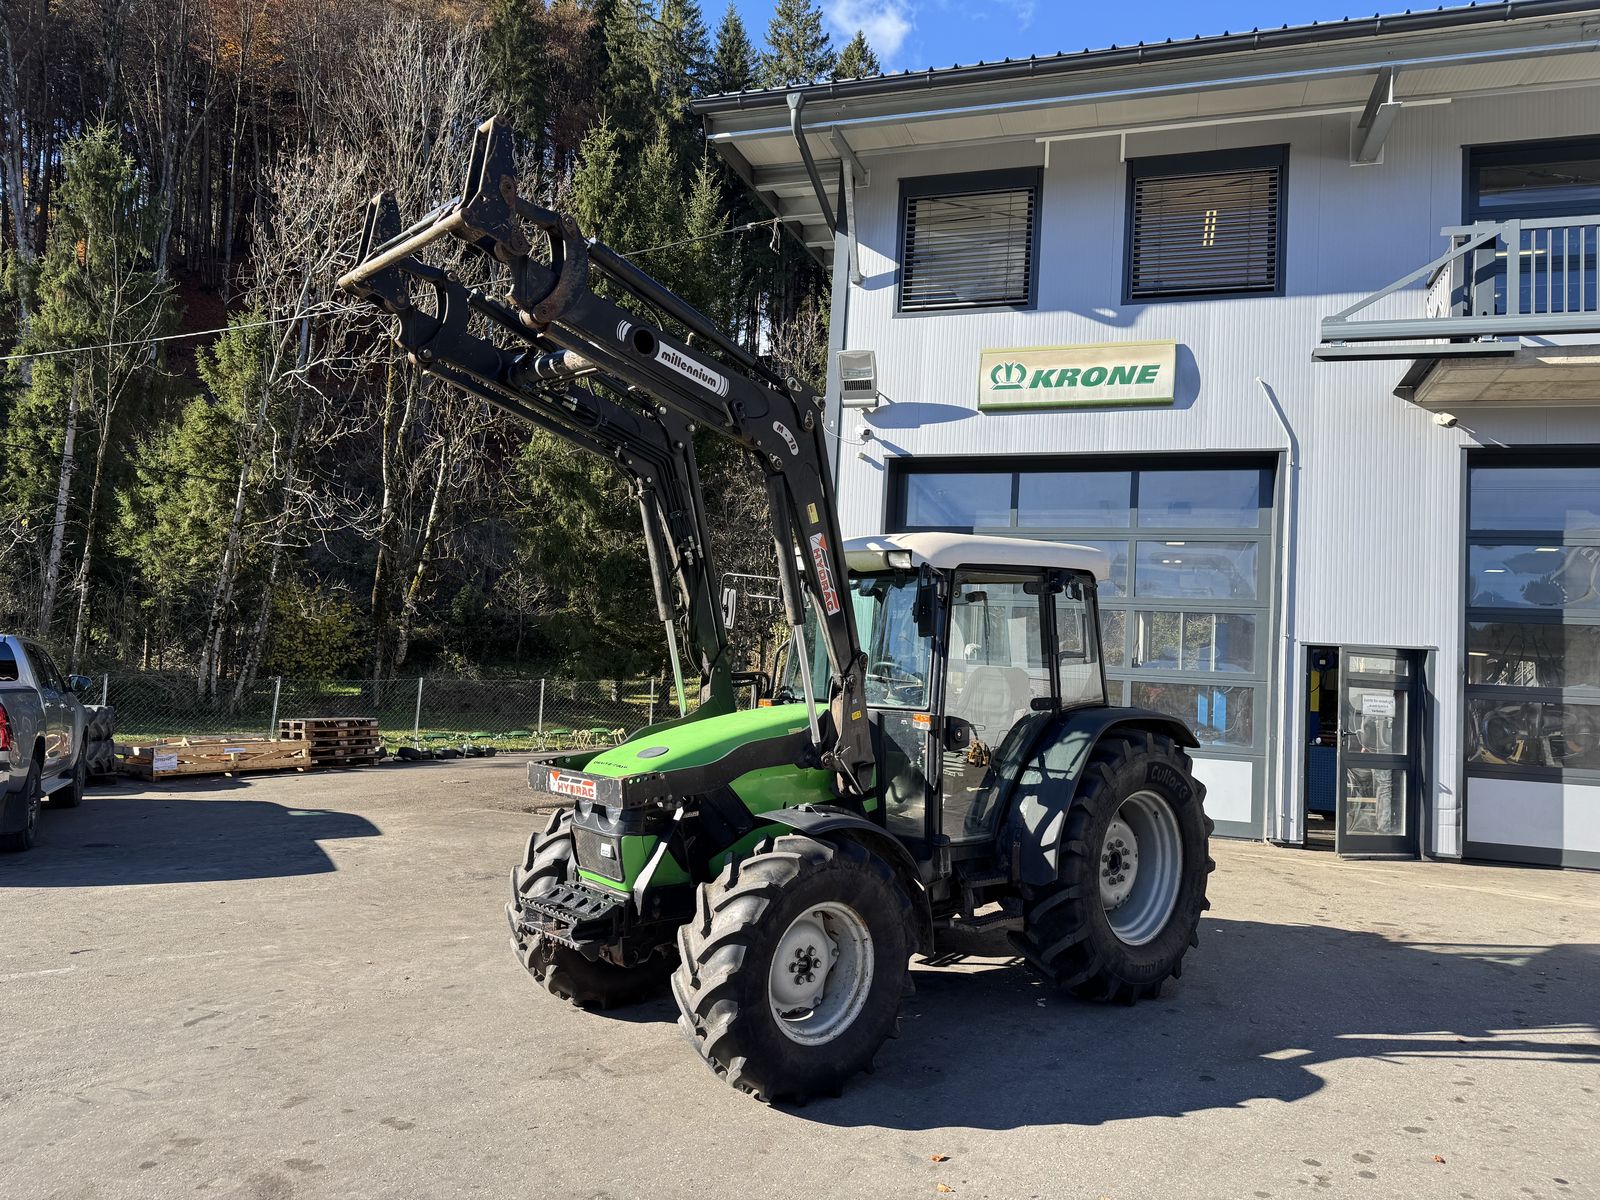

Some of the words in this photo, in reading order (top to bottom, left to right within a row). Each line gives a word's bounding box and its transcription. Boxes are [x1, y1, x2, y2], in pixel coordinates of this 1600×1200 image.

[661, 351, 717, 388] millennium
[1029, 364, 1161, 389] KRONE
[813, 548, 834, 612] HYDRAC
[557, 782, 594, 798] HYDRAC
